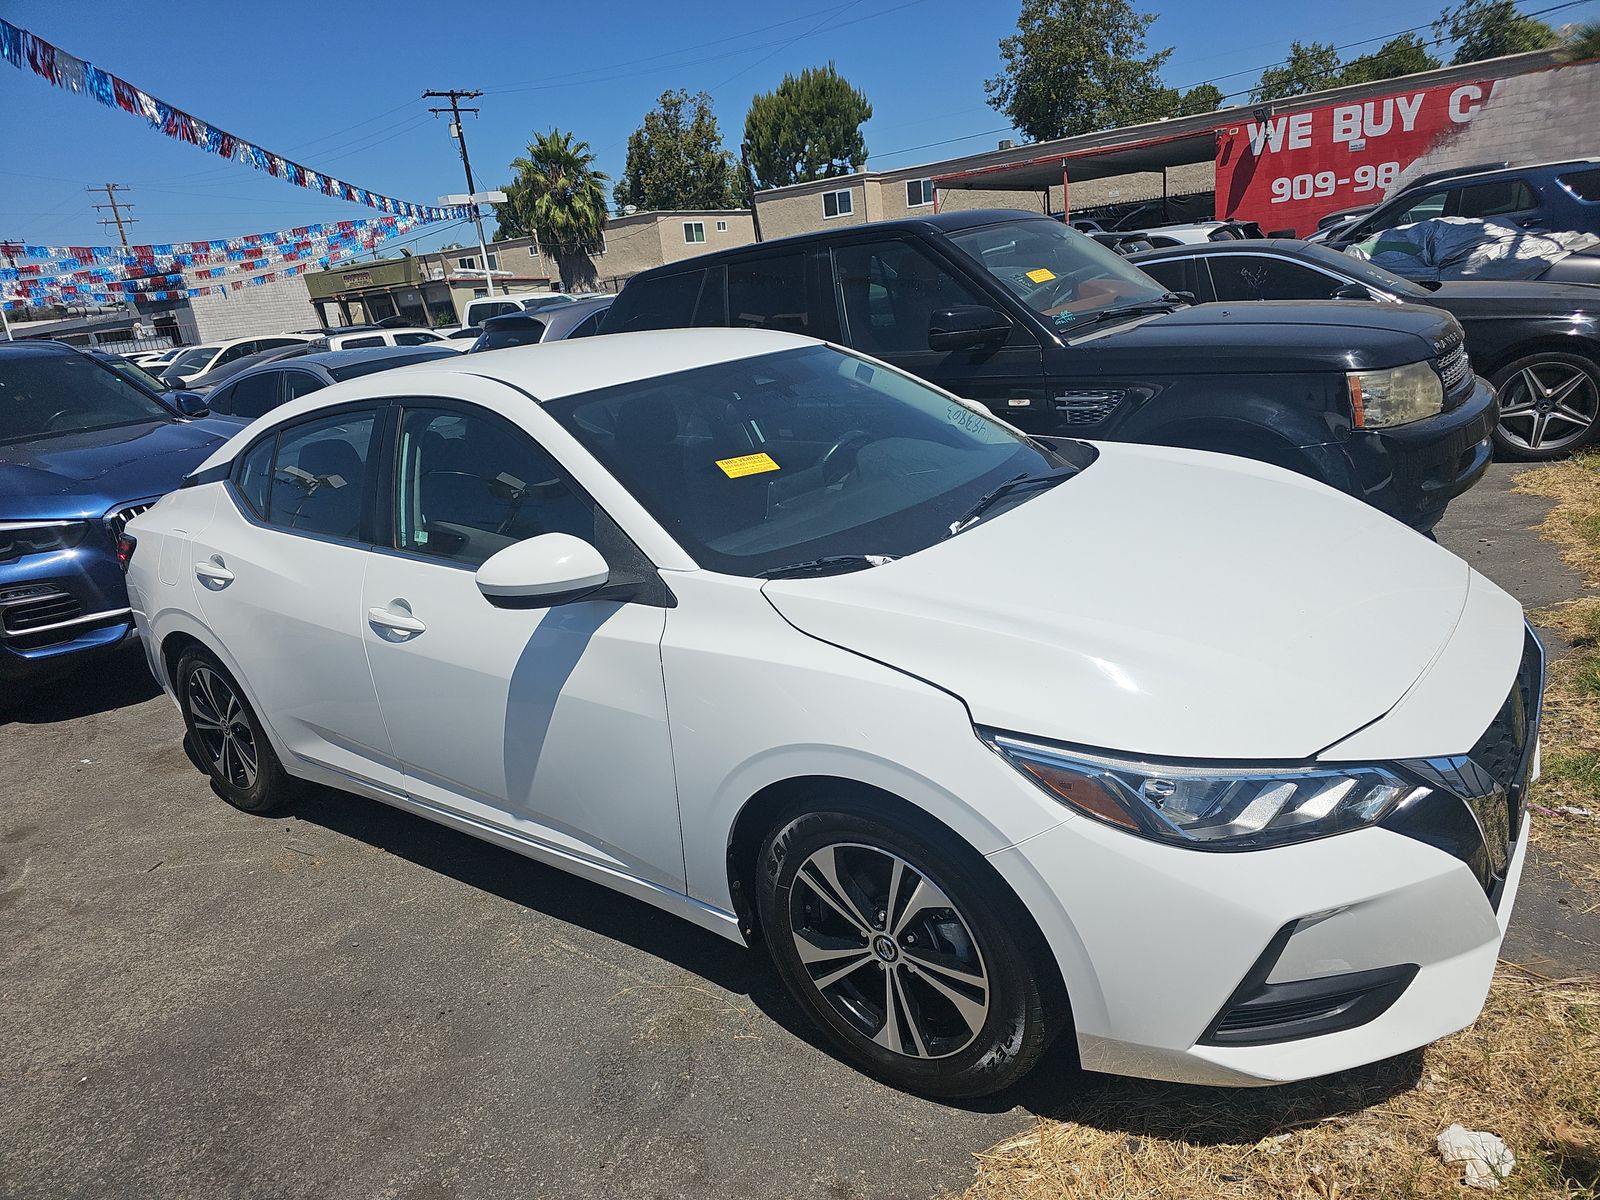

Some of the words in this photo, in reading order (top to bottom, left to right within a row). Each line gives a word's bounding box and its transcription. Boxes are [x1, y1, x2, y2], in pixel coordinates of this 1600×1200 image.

[1247, 112, 1312, 156] WE
[1333, 93, 1425, 143] BUY
[1448, 80, 1503, 123] C
[1433, 332, 1459, 351] RANGE
[721, 458, 737, 466] THIS
[737, 454, 767, 463] VEHICLE
